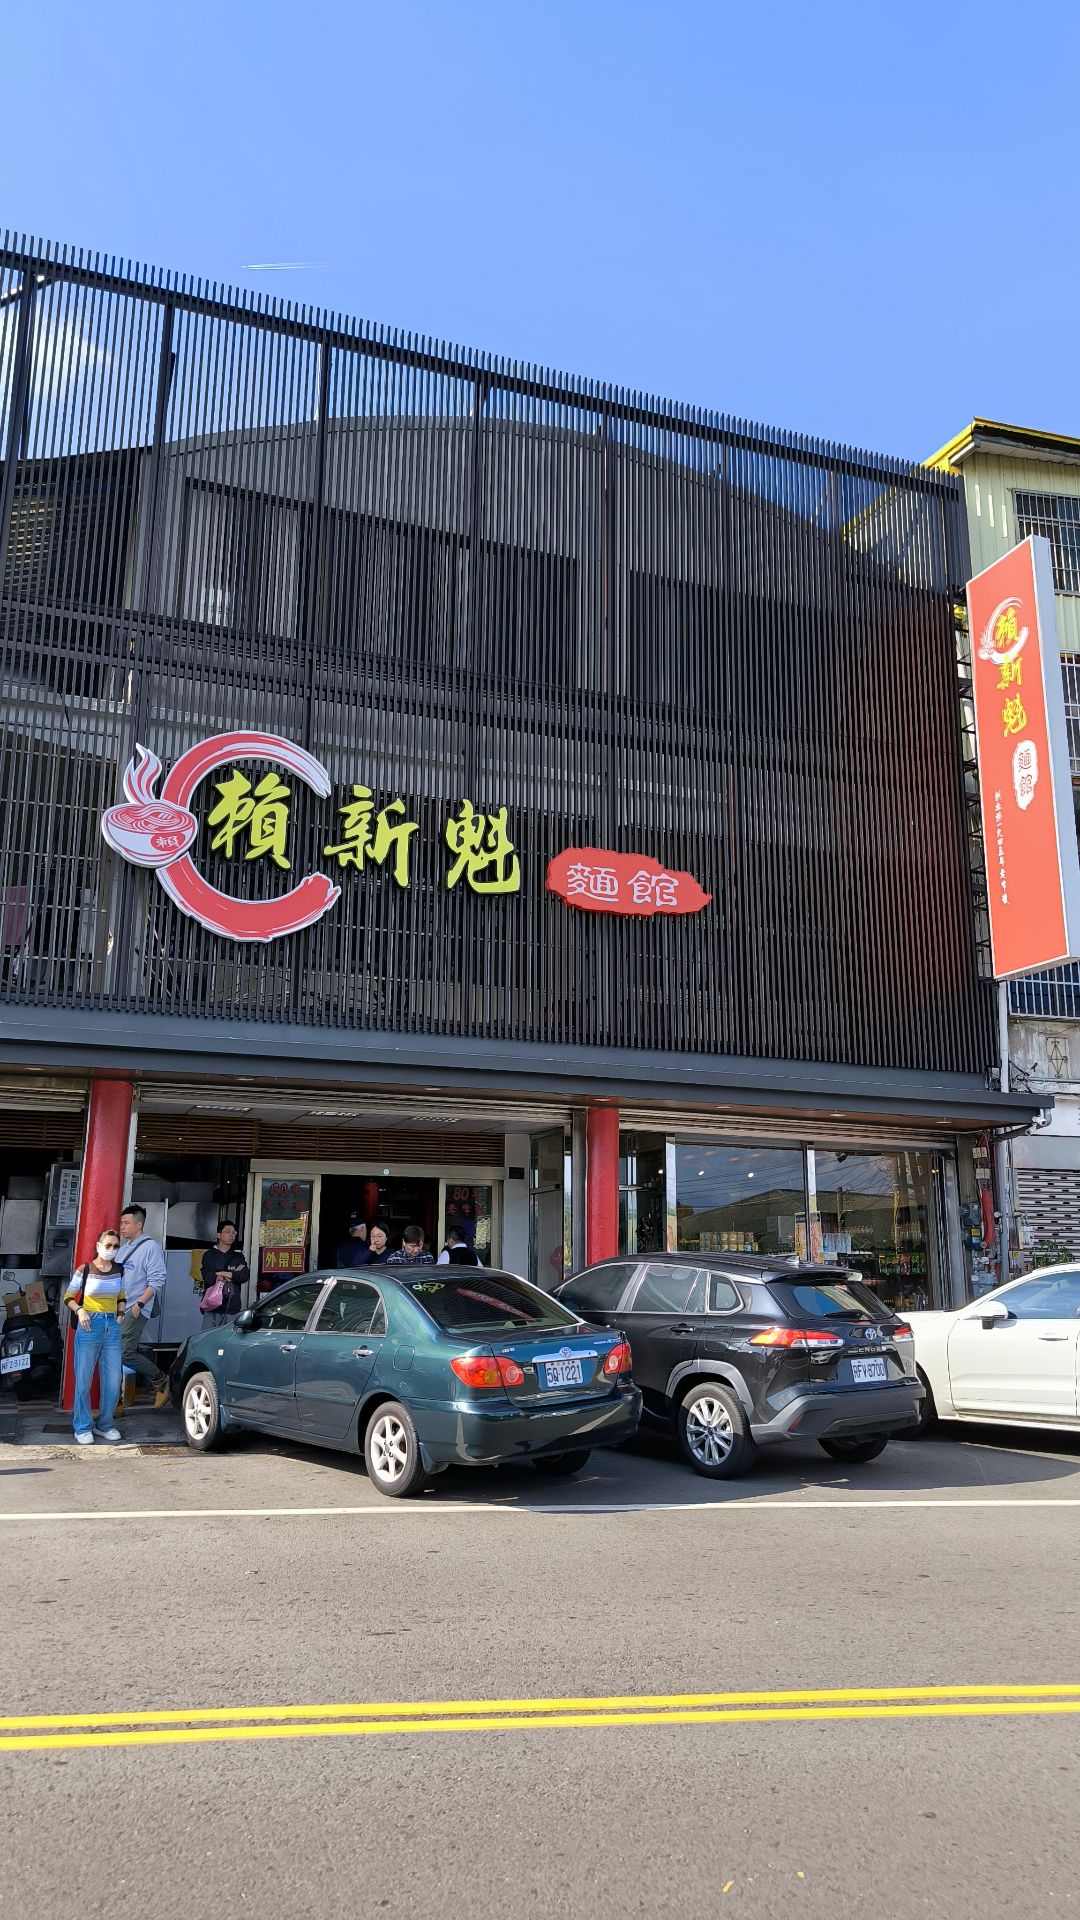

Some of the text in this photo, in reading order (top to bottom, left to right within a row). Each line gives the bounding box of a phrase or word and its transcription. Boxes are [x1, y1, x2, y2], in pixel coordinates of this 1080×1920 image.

[206, 769, 522, 894] 賴新魁
[566, 862, 680, 907] 麵館
[265, 1251, 303, 1268] 外帶區
